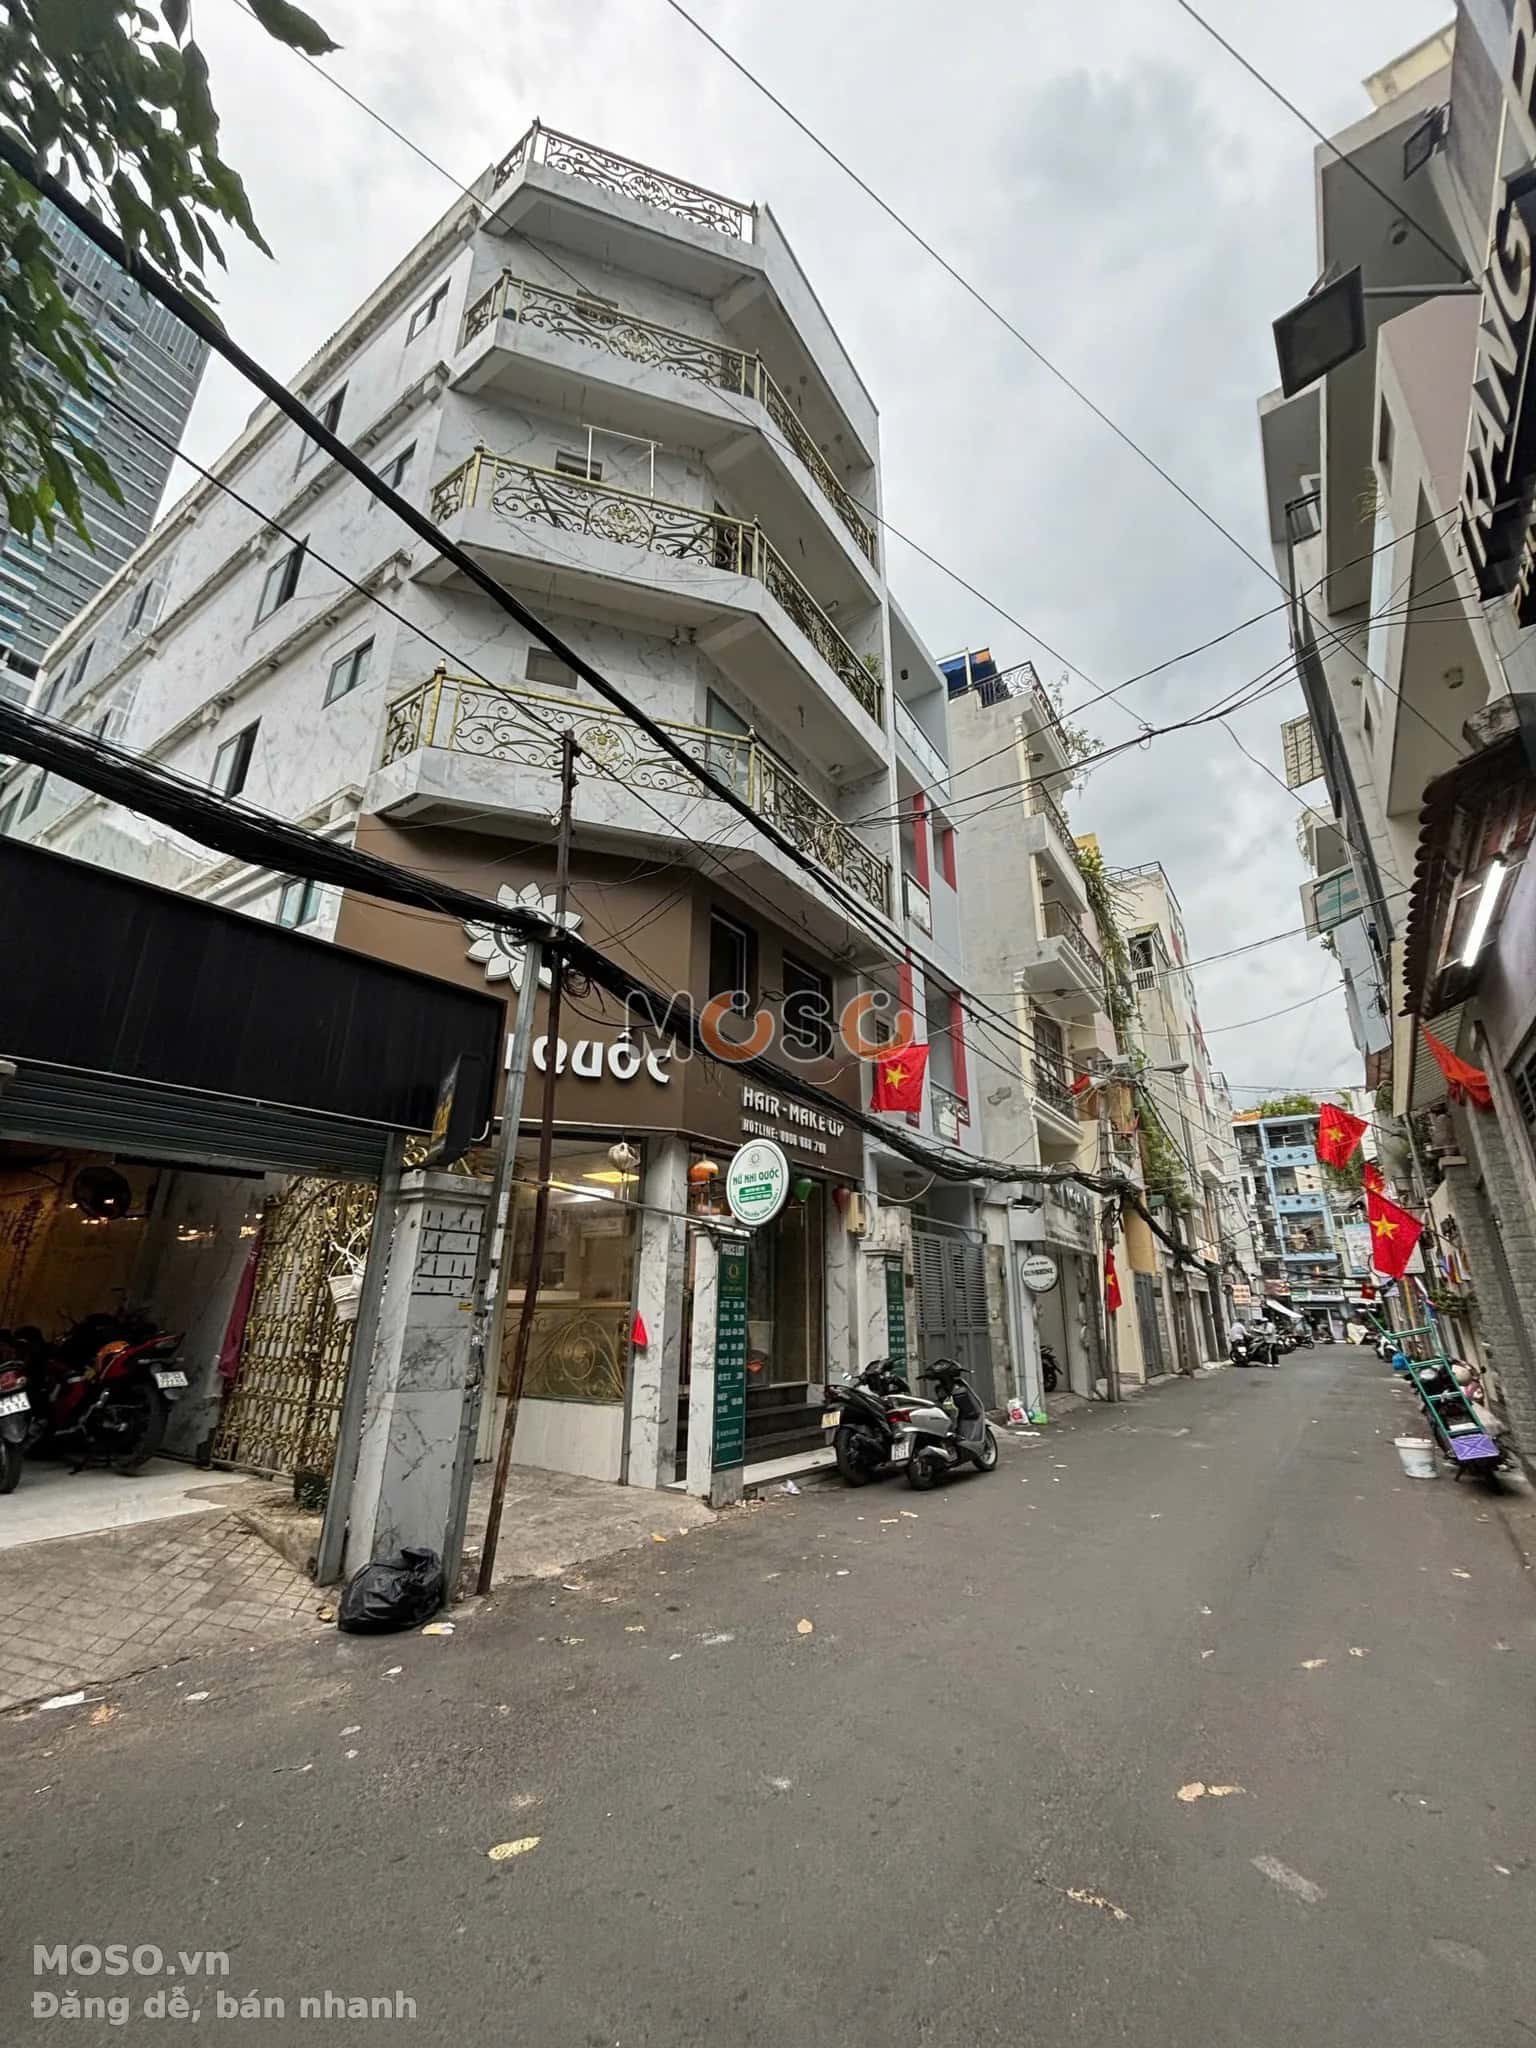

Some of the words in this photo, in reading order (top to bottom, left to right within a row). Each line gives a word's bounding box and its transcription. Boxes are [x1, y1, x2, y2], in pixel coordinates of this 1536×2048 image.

[743, 1086, 780, 1118] HAIR
[789, 1103, 826, 1132] MAKE
[828, 1119, 845, 1137] UP
